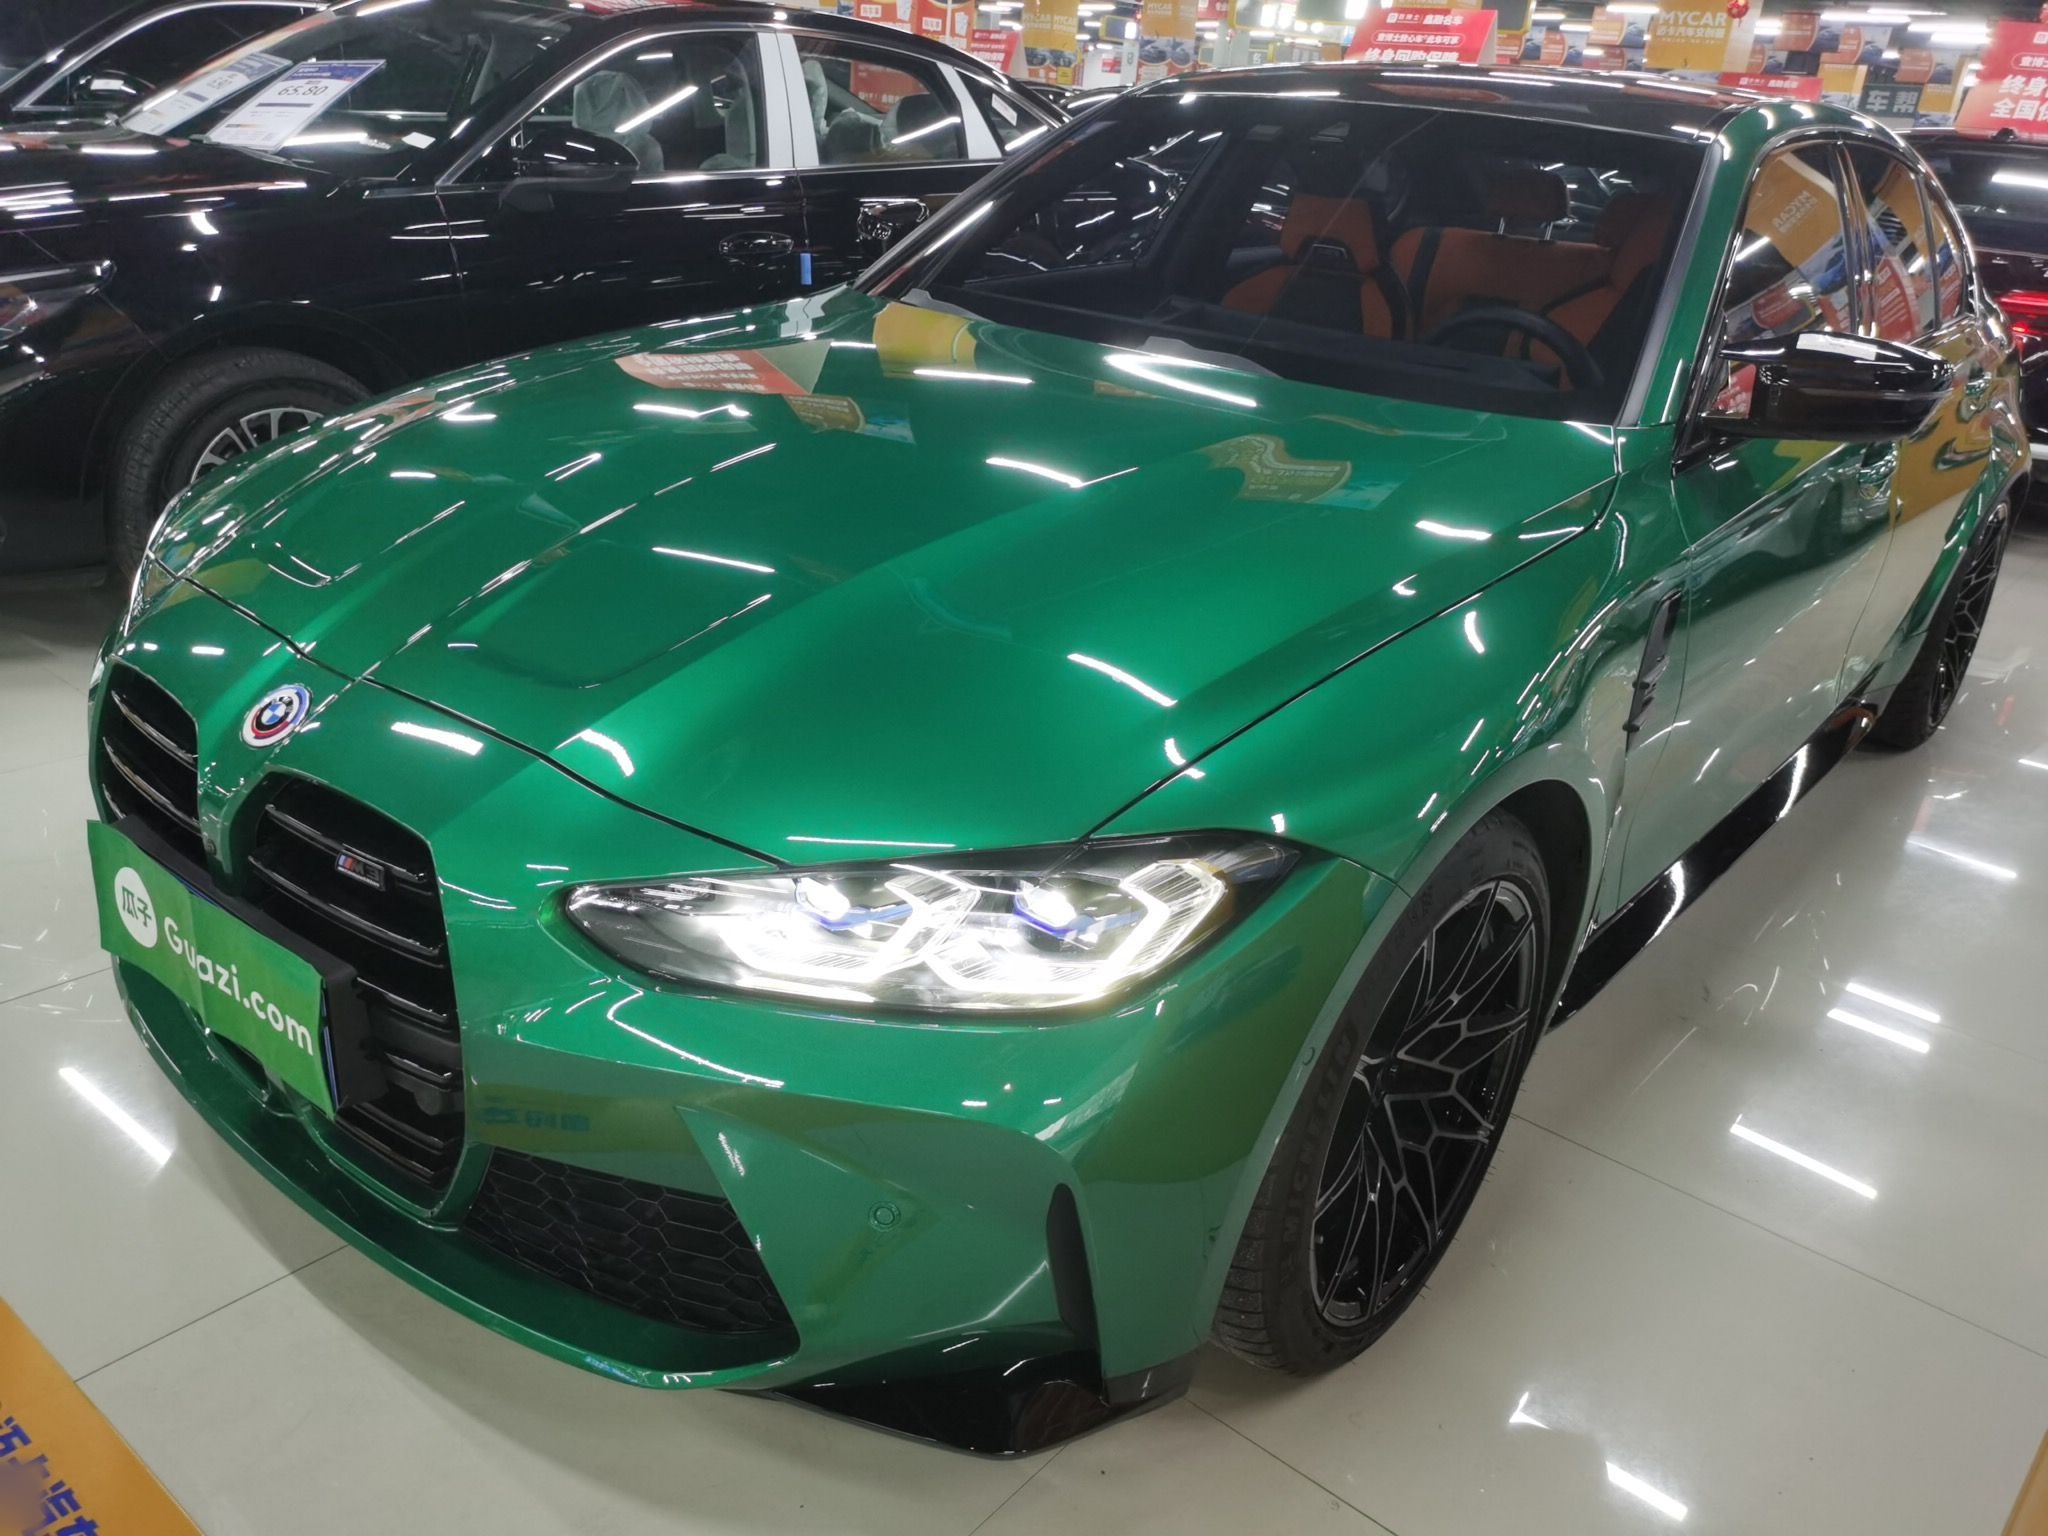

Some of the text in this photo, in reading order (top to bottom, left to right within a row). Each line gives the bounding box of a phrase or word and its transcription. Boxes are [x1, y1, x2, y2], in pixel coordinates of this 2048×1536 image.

[1659, 10, 1728, 26] MYCAR
[277, 86, 329, 96] 65.80
[1998, 74, 2048, 97] 终身
[121, 887, 314, 1056] 瓜子 Guazi.com
